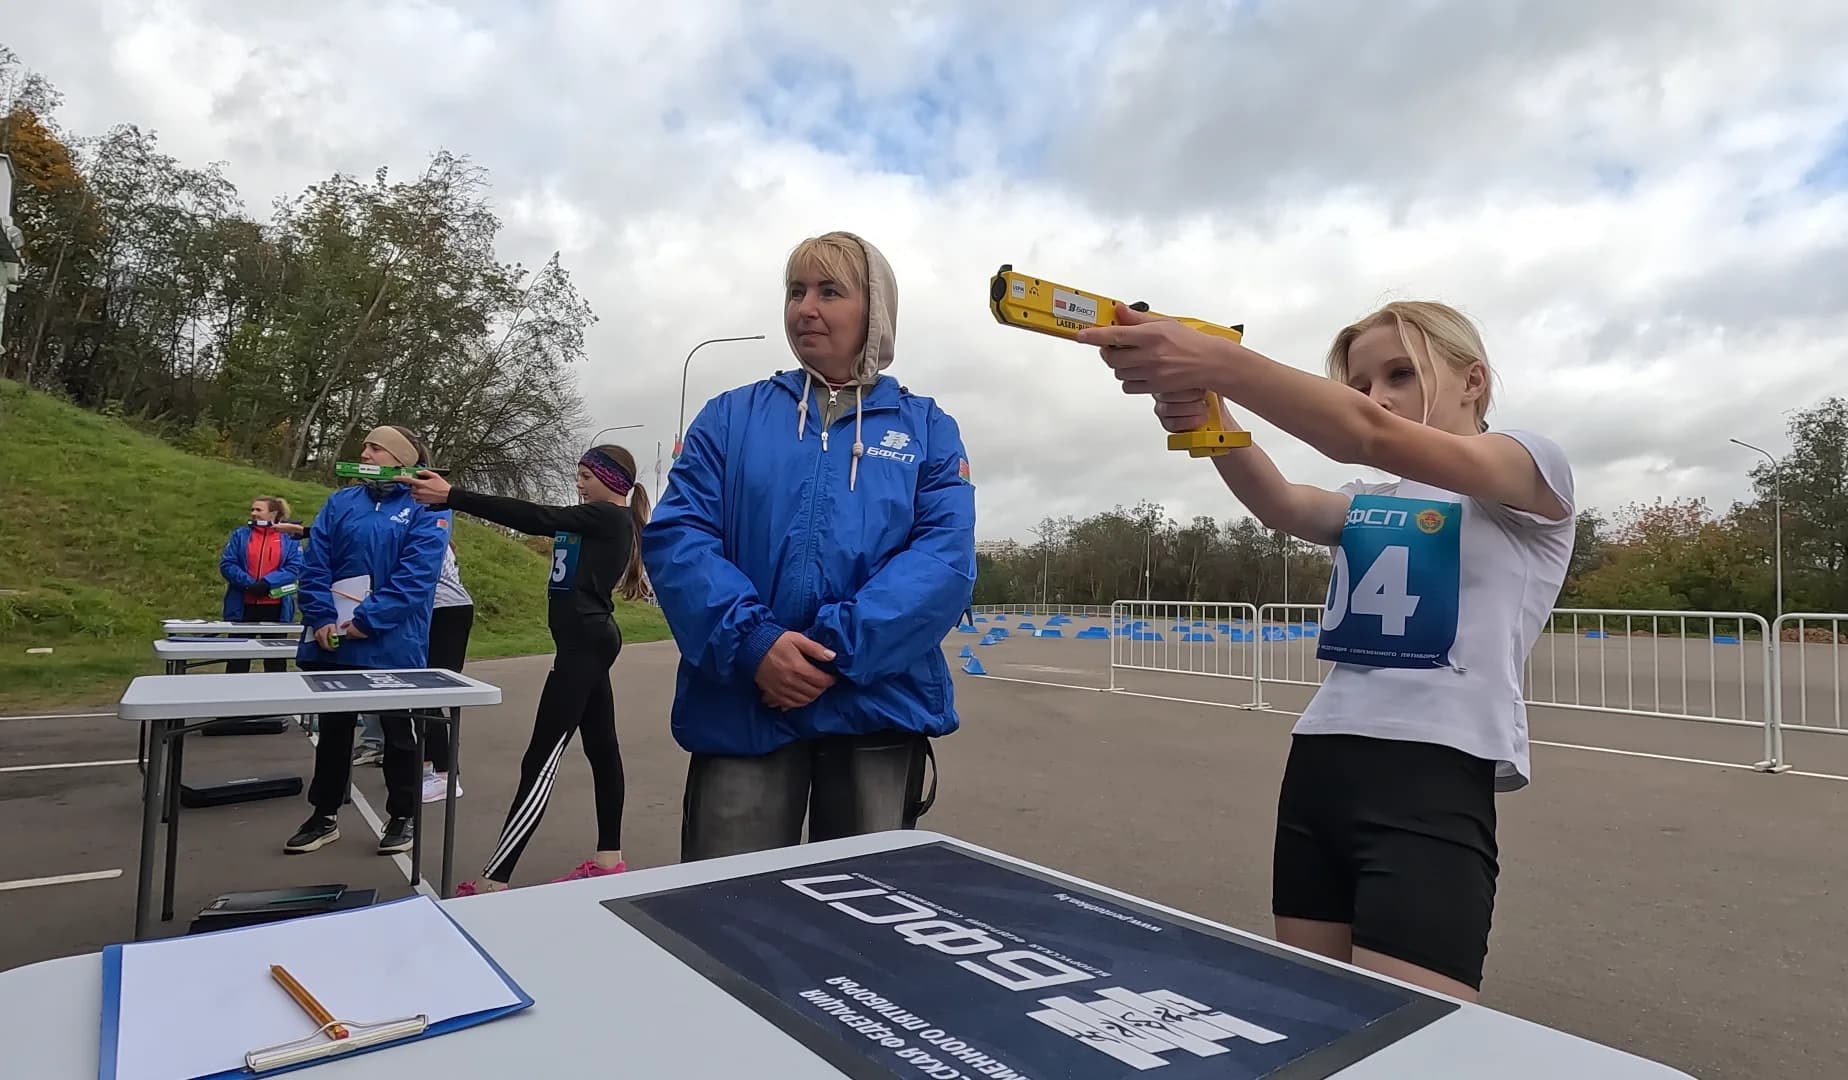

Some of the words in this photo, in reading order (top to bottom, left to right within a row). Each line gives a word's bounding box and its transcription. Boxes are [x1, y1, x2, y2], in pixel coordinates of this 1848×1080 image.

[867, 446, 915, 463] БФСП
[1322, 544, 1421, 637] 04
[781, 874, 1096, 991] БФСП
[799, 988, 905, 1048] ФЕДЕРАЦИЯ
[825, 976, 930, 1031] ПЯТИБОРЬЯ
